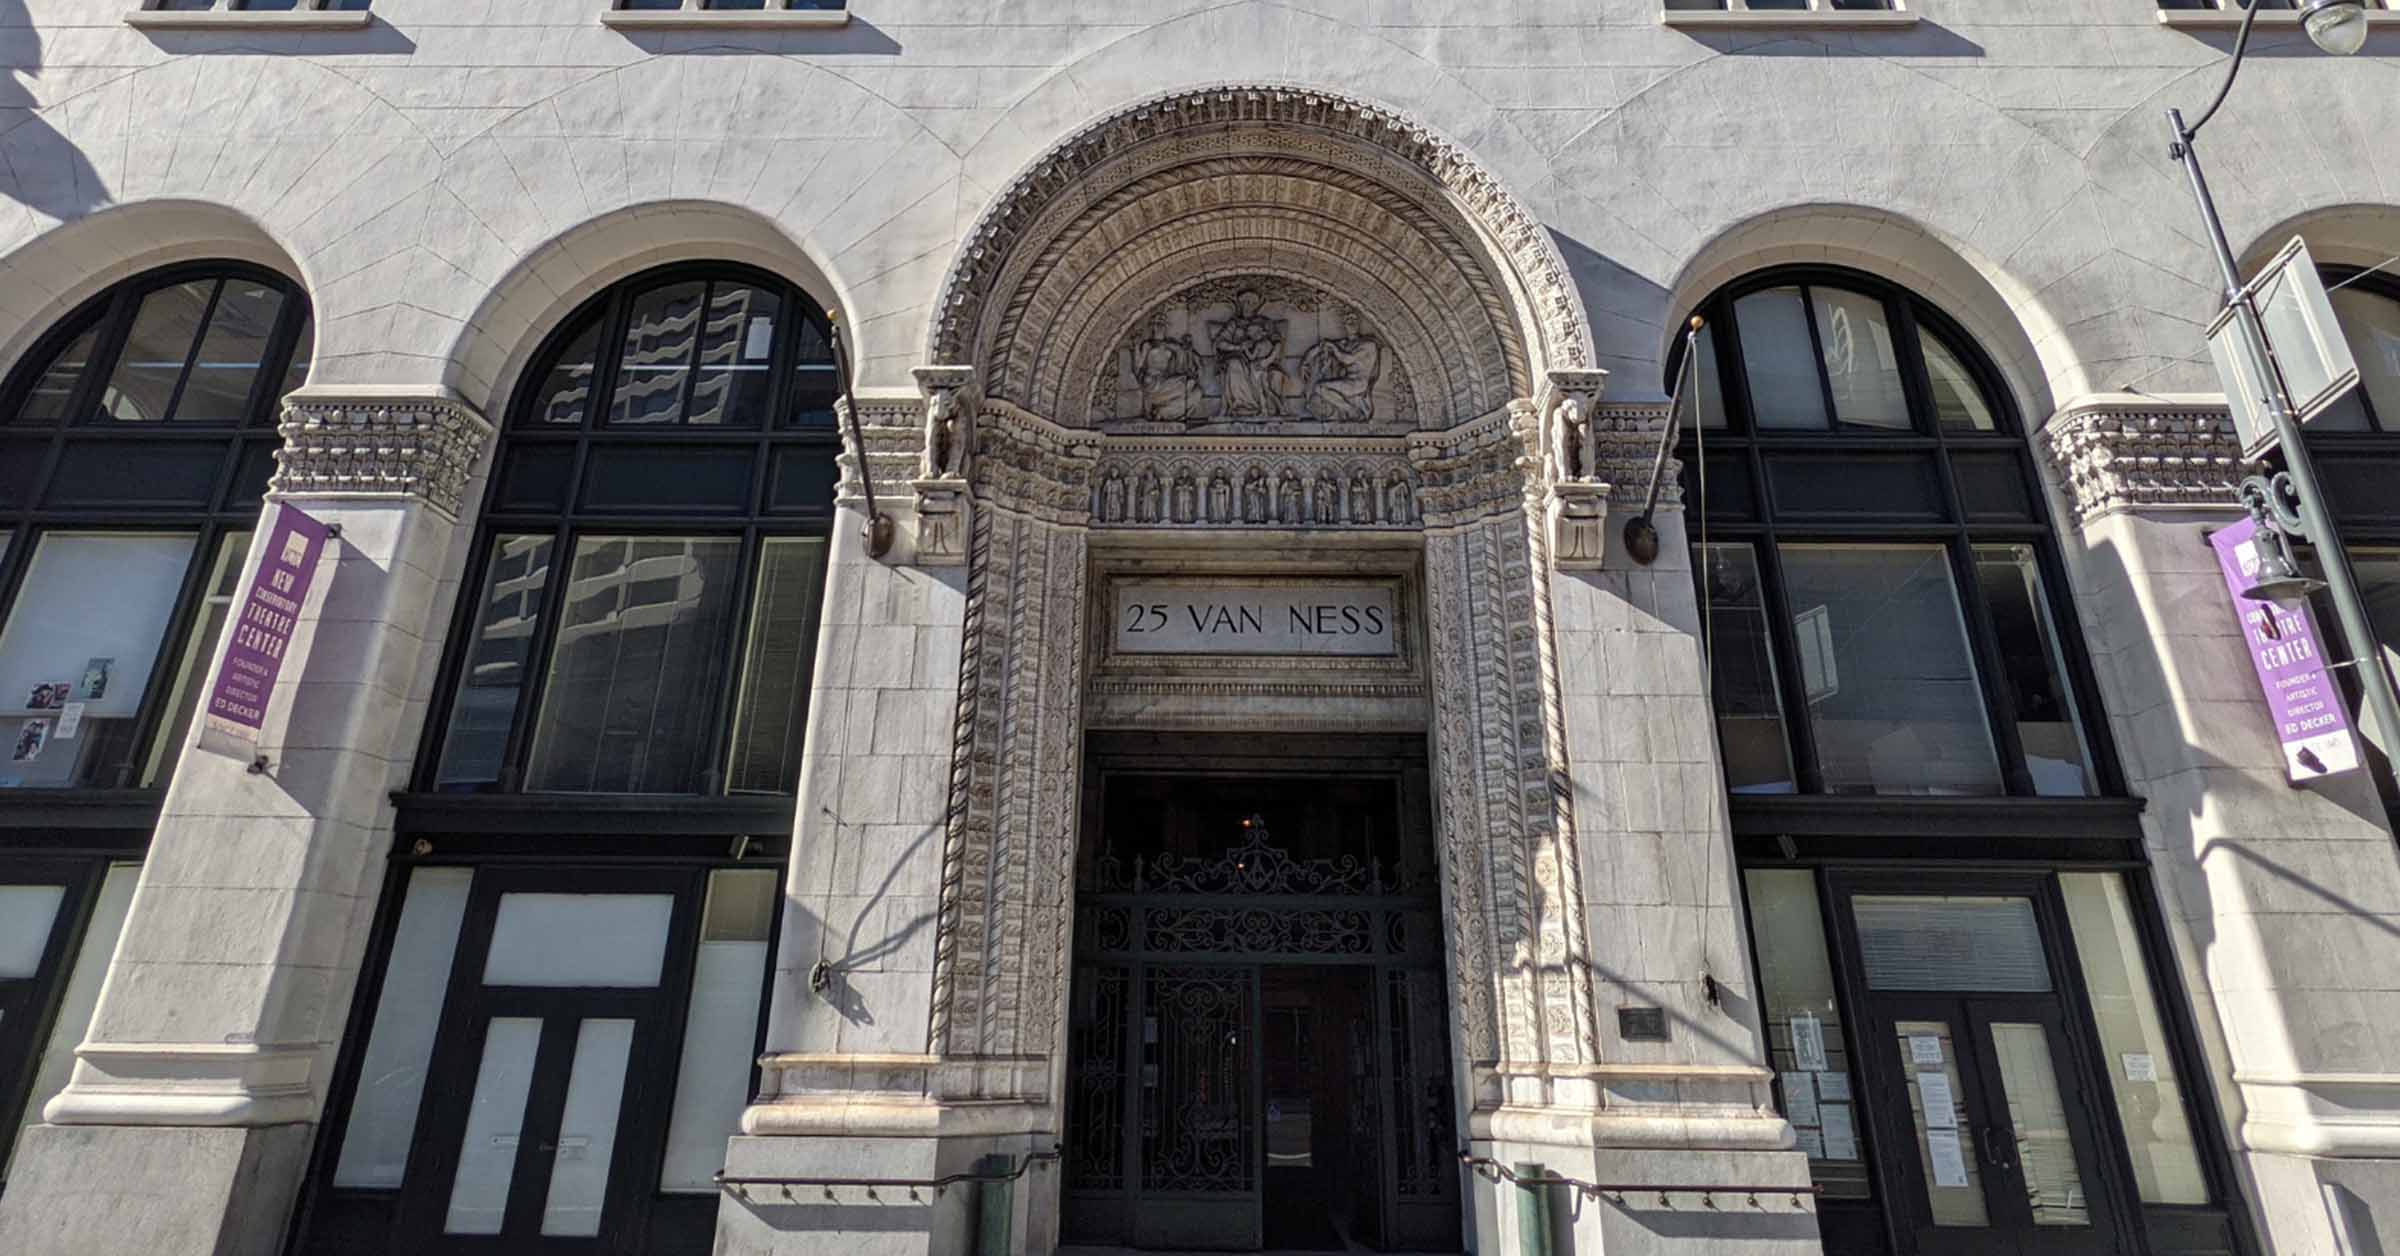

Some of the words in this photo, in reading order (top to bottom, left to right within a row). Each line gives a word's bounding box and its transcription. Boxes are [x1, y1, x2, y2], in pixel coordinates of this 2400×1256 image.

[271, 568, 295, 593] NEW
[247, 601, 292, 635] THEATRE
[1126, 604, 1168, 632] 25
[1187, 604, 1263, 633] VAN
[1289, 605, 1384, 634] NESS
[2252, 615, 2302, 646] THTRE
[237, 623, 283, 659] CENTER
[2261, 638, 2312, 671] CENTER
[214, 697, 226, 709] ED
[227, 702, 260, 719] DECKER
[2287, 701, 2324, 717] DIRECTOR
[2285, 722, 2299, 735] ED
[2300, 713, 2336, 731] DECKER
